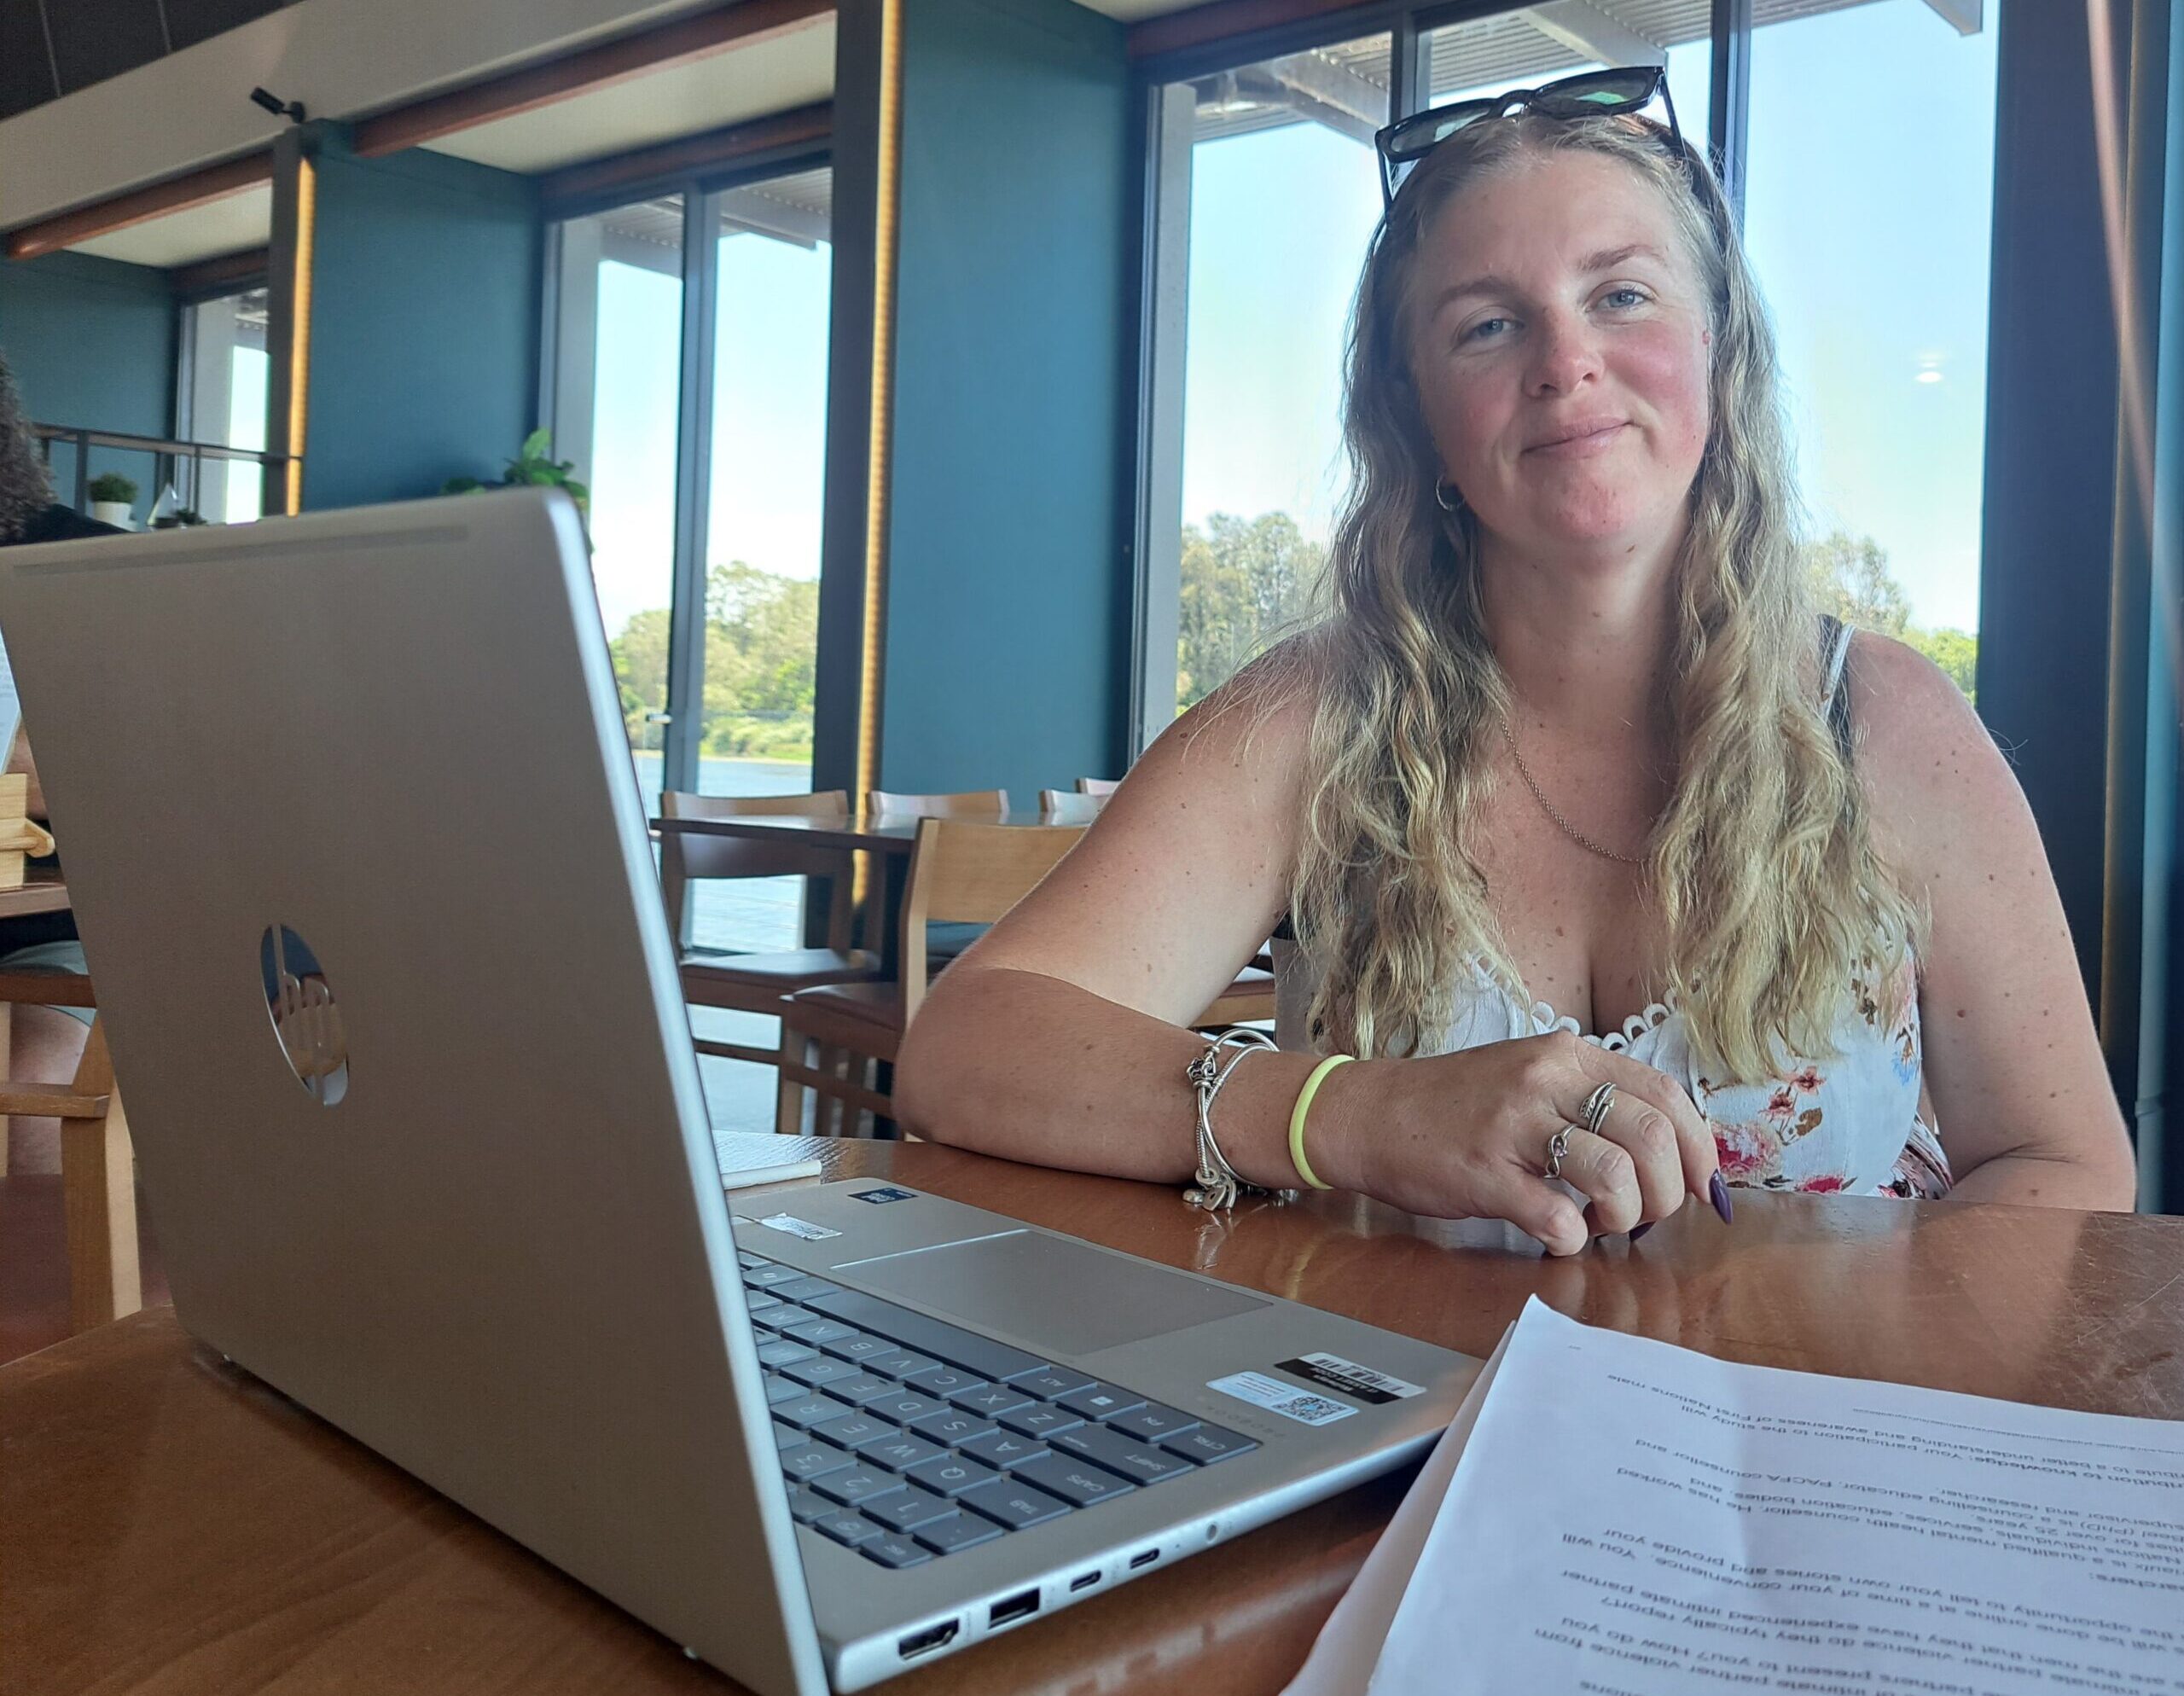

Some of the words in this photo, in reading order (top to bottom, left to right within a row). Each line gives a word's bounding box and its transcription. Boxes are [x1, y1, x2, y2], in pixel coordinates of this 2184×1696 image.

[261, 924, 349, 1106] hp
[851, 1342, 872, 1350] B
[935, 1376, 957, 1385] C
[1039, 1377, 1065, 1386] ALT
[1337, 1374, 1366, 1391] ASSET
[1606, 1374, 1647, 1389] male
[979, 1394, 1006, 1405] X
[1651, 1386, 1711, 1411] Nations
[799, 1404, 818, 1413] R
[898, 1402, 921, 1411] D
[1681, 1404, 1708, 1418] will
[1027, 1413, 1054, 1424] Z
[1711, 1414, 1756, 1430] study
[1716, 1407, 1751, 1422] First
[842, 1424, 868, 1433] E
[943, 1421, 967, 1431] S
[1761, 1426, 1787, 1434] the
[1777, 1418, 1869, 1435] awareness
[1792, 1428, 1809, 1437] to
[1193, 1435, 1225, 1449] CTRL
[1814, 1431, 1918, 1452] participation
[1873, 1430, 1907, 1441] and
[885, 1445, 916, 1457] W
[996, 1441, 1020, 1451] A
[1635, 1438, 1668, 1454] and
[1911, 1435, 2035, 1462] understanding
[795, 1454, 822, 1467] 3
[1923, 1448, 1963, 1461] Your
[1124, 1455, 1165, 1471] SHIFT
[1672, 1451, 1763, 1479] counsellor
[2040, 1457, 2092, 1471] better
[2112, 1466, 2130, 1475] to
[940, 1467, 966, 1479] Q
[1616, 1467, 1683, 1491] worked
[2082, 1472, 2103, 1481] to
[845, 1477, 872, 1487] 2
[1066, 1474, 1105, 1491] CAPS
[1689, 1477, 1723, 1493] and
[1766, 1474, 1833, 1489] PACFA
[1687, 1487, 1720, 1505] has
[897, 1502, 918, 1512] 1
[1009, 1500, 1037, 1514] TAB
[1726, 1501, 1752, 1513] He
[1801, 1498, 1894, 1518] education
[1928, 1495, 2034, 1520] counselling
[2044, 1507, 2080, 1518] and
[1866, 1518, 1925, 1536] health
[2058, 1519, 2073, 1528] is
[2079, 1520, 2135, 1536] (PhD)
[2088, 1513, 2184, 1531] supervisor
[1603, 1529, 1647, 1545] your
[2034, 1525, 2059, 1536] 25
[2065, 1530, 2107, 1542] over
[1562, 1532, 1594, 1548] will
[1930, 1529, 1997, 1548] mental
[2113, 1537, 2140, 1548] for
[1599, 1542, 1636, 1560] You
[1652, 1541, 1725, 1568] provide
[2002, 1542, 2087, 1562] qualified
[2104, 1547, 2181, 1565] Nations
[2111, 1560, 2128, 1569] is
[1561, 1569, 1635, 1595] partner
[1774, 1568, 1842, 1583] stories
[1849, 1576, 1891, 1589] own
[1788, 1583, 1833, 1594] your
[1839, 1589, 1860, 1599] of
[1899, 1584, 1943, 1598] your
[1640, 1590, 1722, 1618] intimate
[1867, 1592, 1912, 1607] time
[1918, 1600, 1931, 1609] a
[1949, 1594, 1980, 1607] tell
[1986, 1600, 2007, 1612] to
[1937, 1604, 1957, 1614] at
[1561, 1617, 1600, 1635] you
[1727, 1611, 1860, 1632] experienced
[1964, 1609, 2029, 1629] online
[2013, 1604, 2132, 1633] opportunity
[1682, 1614, 1768, 1641] typically
[1867, 1625, 1920, 1643] have
[2036, 1623, 2090, 1640] done
[2140, 1628, 2174, 1641] the
[1534, 1628, 1583, 1650] from
[1606, 1629, 1635, 1645] do
[1774, 1630, 1821, 1645] they
[1827, 1636, 1856, 1648] do
[1927, 1633, 1974, 1652] they
[2097, 1635, 2126, 1647] be
[1640, 1638, 1690, 1658] How
[1862, 1640, 1954, 1660] violence
[1981, 1645, 2024, 1662] that
[2131, 1640, 2167, 1652] will
[1589, 1643, 1681, 1670] violence
[1696, 1651, 1751, 1667] you?
[2030, 1654, 2079, 1671] men
[1757, 1660, 1780, 1673] to
[1786, 1664, 1872, 1681] present
[1963, 1656, 2042, 1679] partner
[2086, 1665, 2123, 1680] the
[1688, 1664, 1770, 1686] partner
